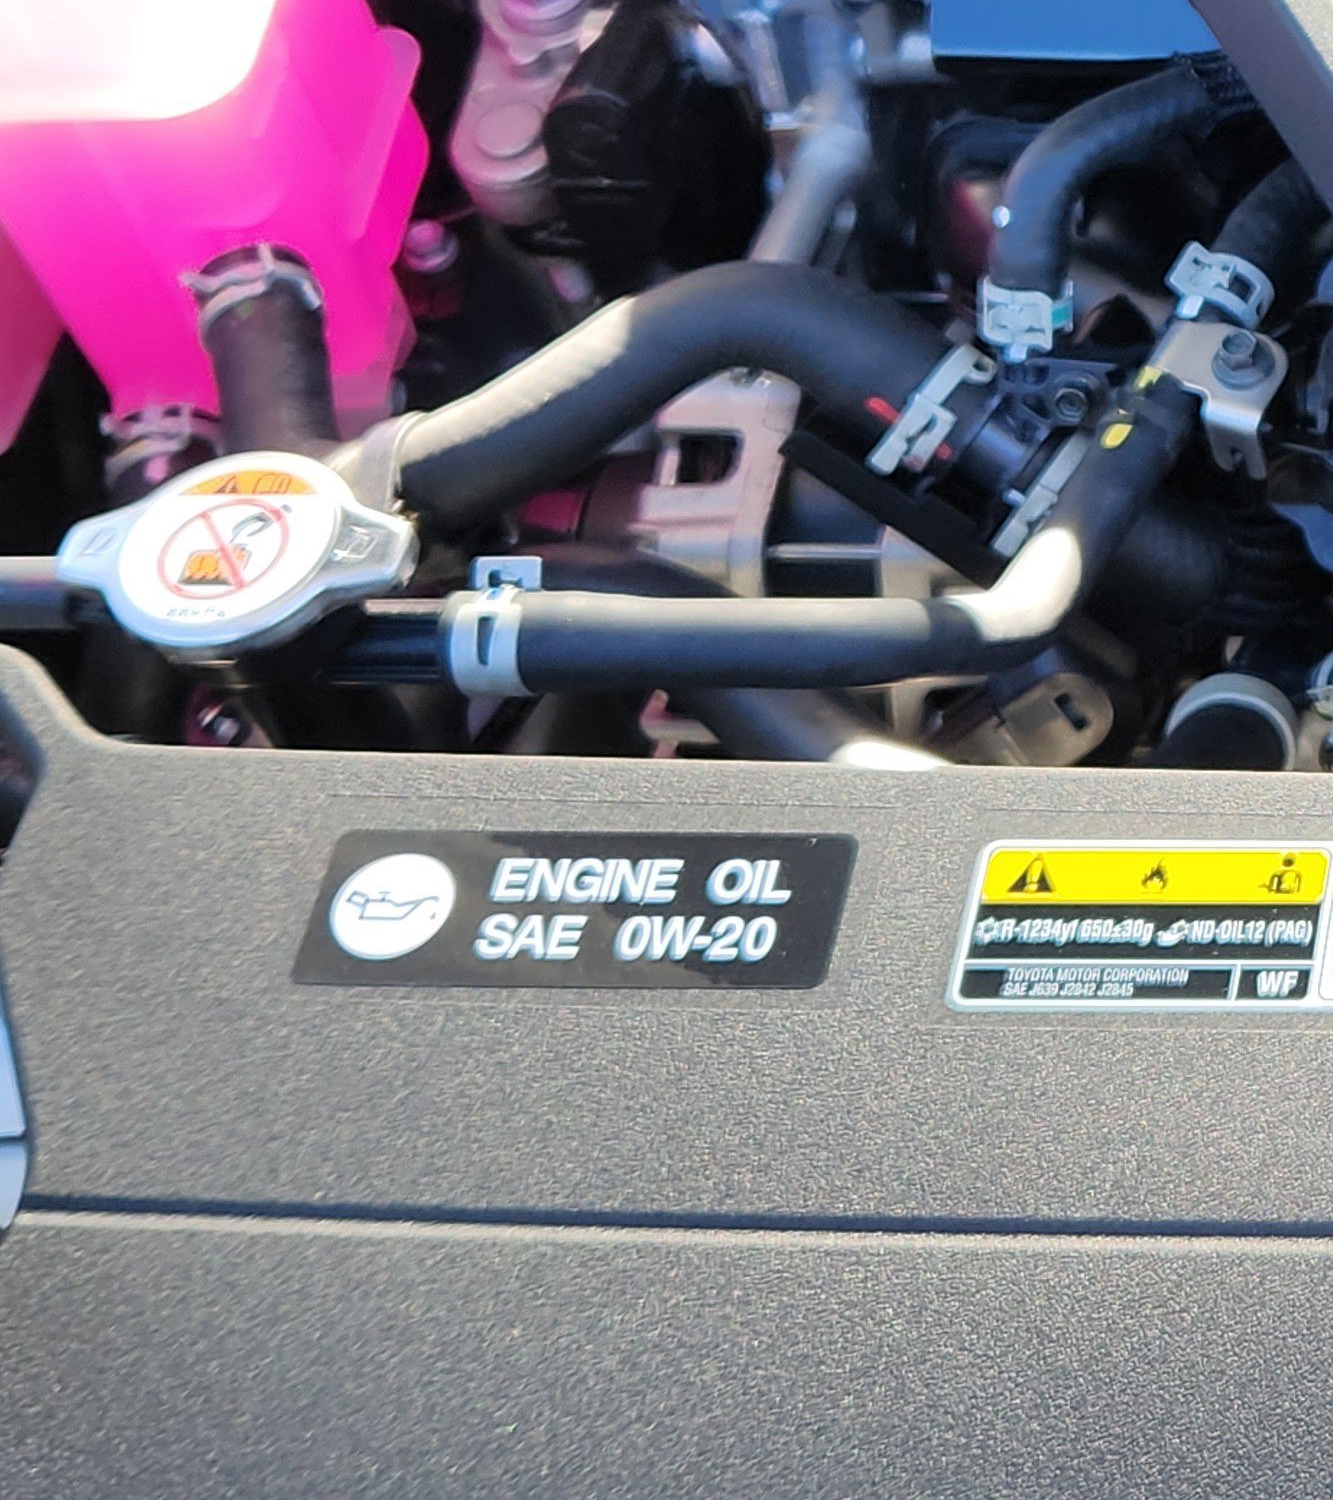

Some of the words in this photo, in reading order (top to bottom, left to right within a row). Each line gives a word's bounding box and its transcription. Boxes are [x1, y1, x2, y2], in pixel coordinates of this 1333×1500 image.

[490, 857, 685, 904] ENGINE
[705, 858, 792, 905] OIL
[473, 913, 589, 960] SAE
[613, 915, 777, 962] 0W-20
[1265, 919, 1313, 947] (PAG)
[1001, 982, 1028, 997] SAE
[1028, 982, 1059, 997] J639
[1003, 967, 1054, 983] TOYOTA
[1055, 967, 1101, 983] MOTOR
[1102, 967, 1190, 987] CORPORATION
[1257, 971, 1299, 997] WF
